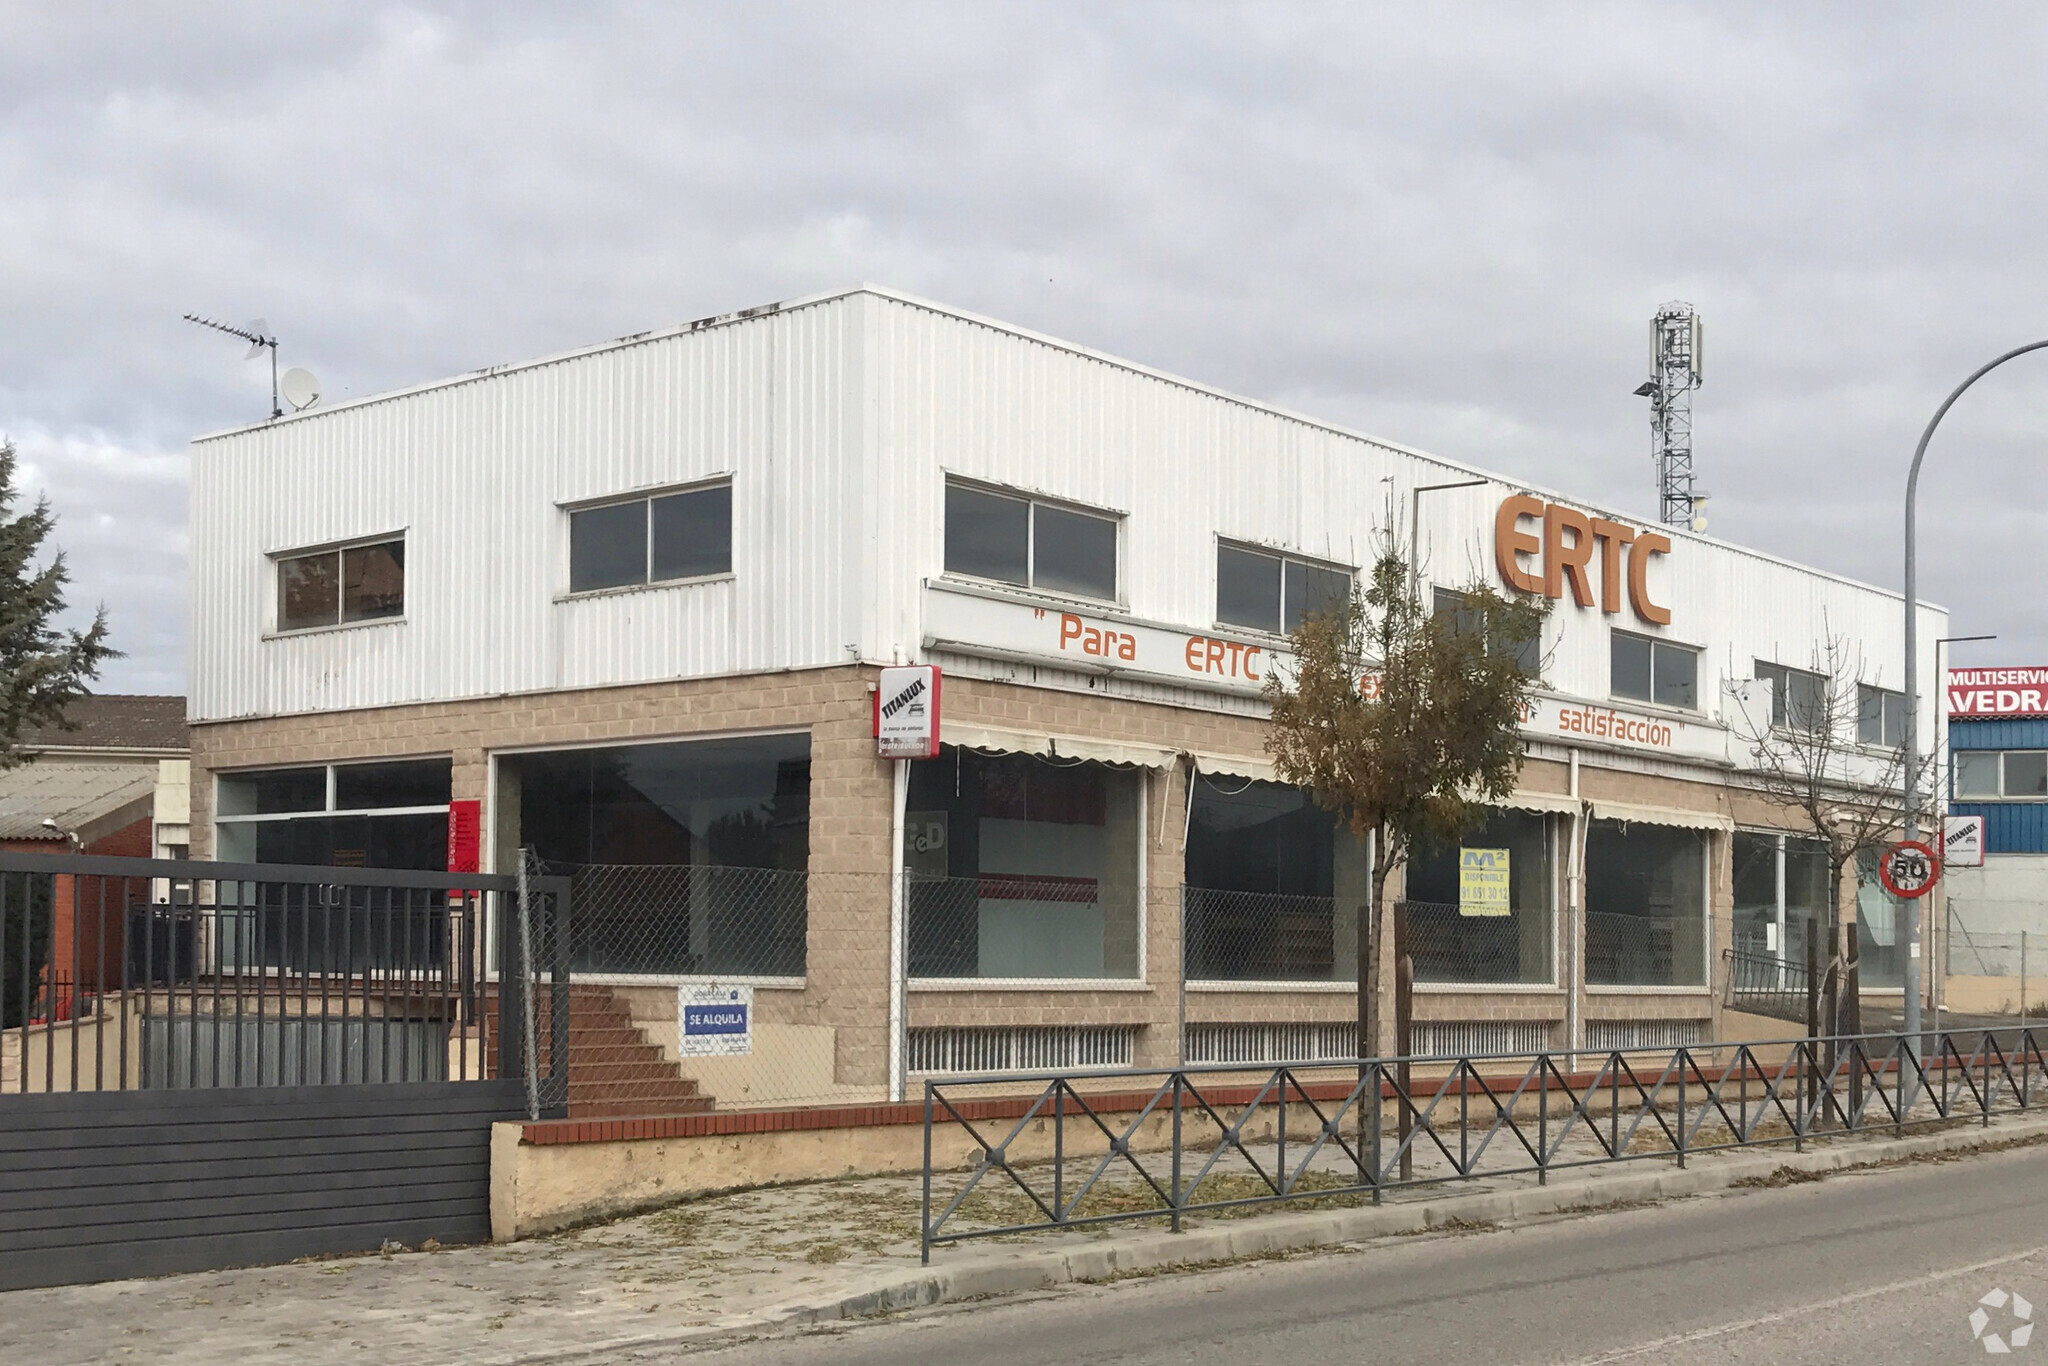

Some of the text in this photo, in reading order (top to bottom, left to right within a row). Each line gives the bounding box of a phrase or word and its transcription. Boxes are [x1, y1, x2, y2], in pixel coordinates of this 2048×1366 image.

[1495, 495, 1671, 626] ERTC
[1060, 613, 1136, 661] Para
[1185, 637, 1261, 681] ERTC
[1559, 704, 1671, 747] satisfacción
[881, 677, 926, 719] TITANLUX
[1948, 690, 2048, 712] VEDR
[1946, 822, 1977, 846] TITANLUX
[1465, 873, 1504, 882] DISPONIBLE
[1894, 859, 1926, 879] 50
[689, 1013, 743, 1025] SE ALQUILA
